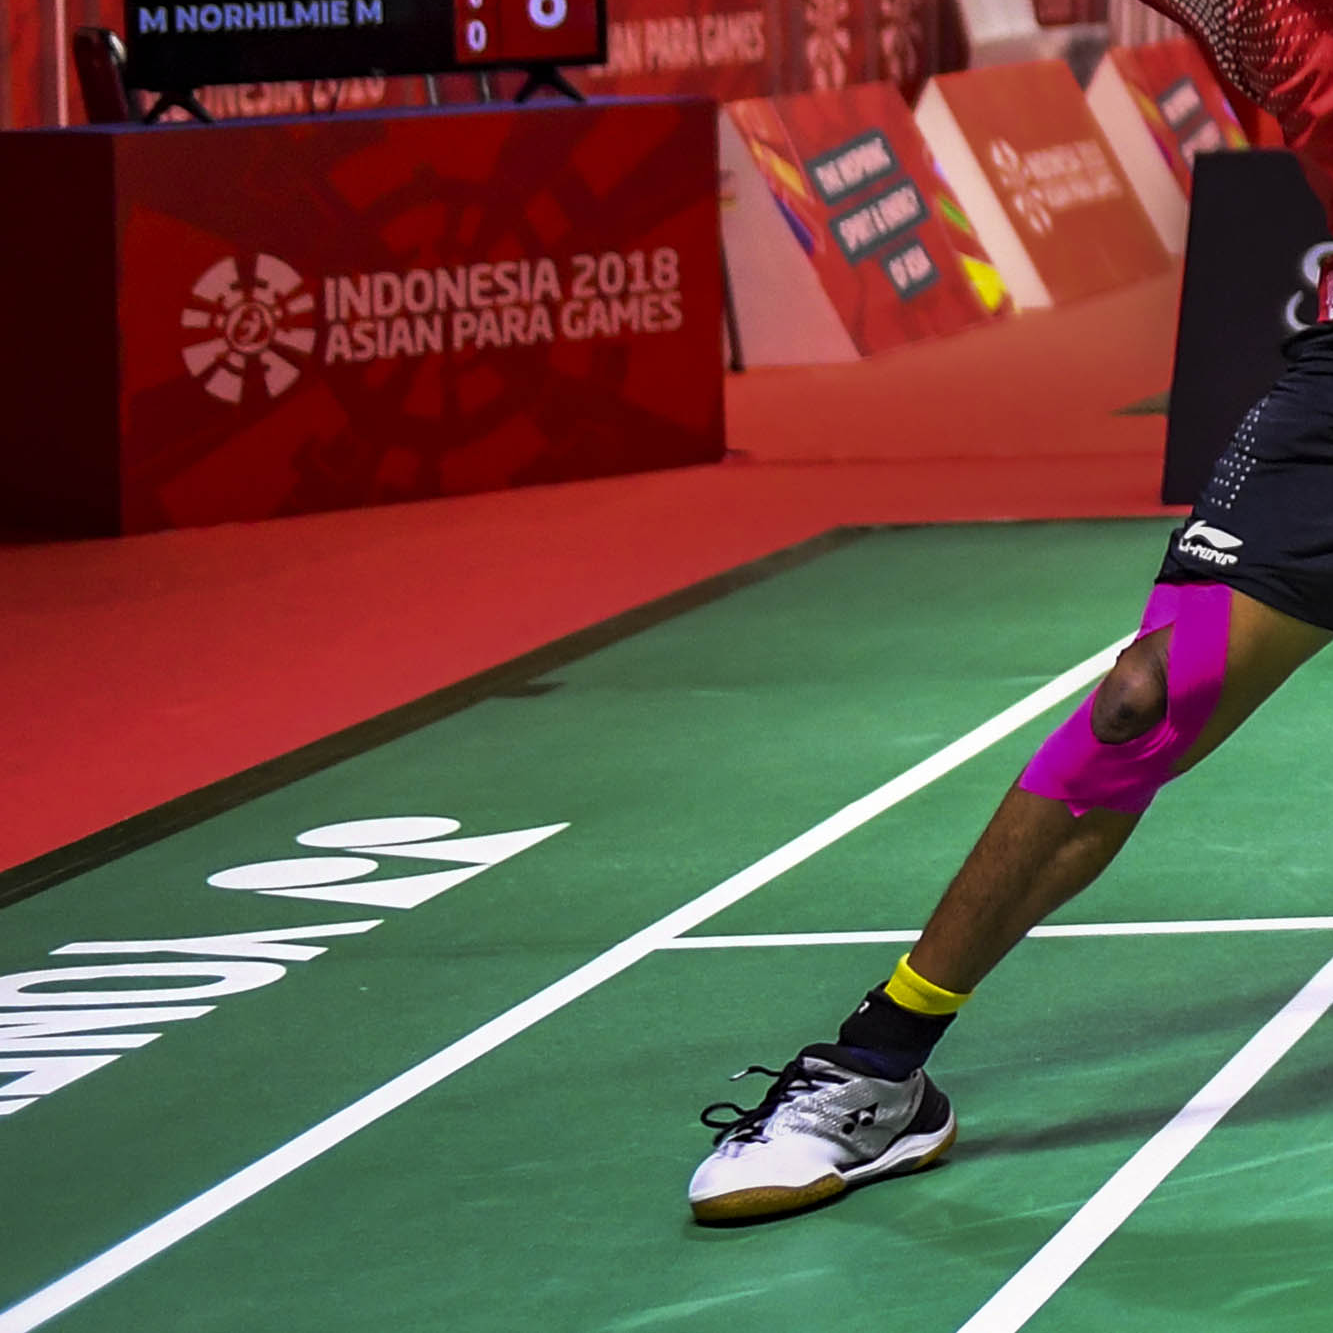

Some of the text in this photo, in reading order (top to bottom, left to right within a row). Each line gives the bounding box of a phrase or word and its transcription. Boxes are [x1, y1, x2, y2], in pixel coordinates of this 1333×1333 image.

[139, 6, 168, 33] M
[174, 0, 349, 32] NORHILMIE
[467, 19, 487, 52] 0
[324, 247, 680, 320] INDONESIA 2018
[325, 291, 683, 364] ASIAN PARA GAMES
